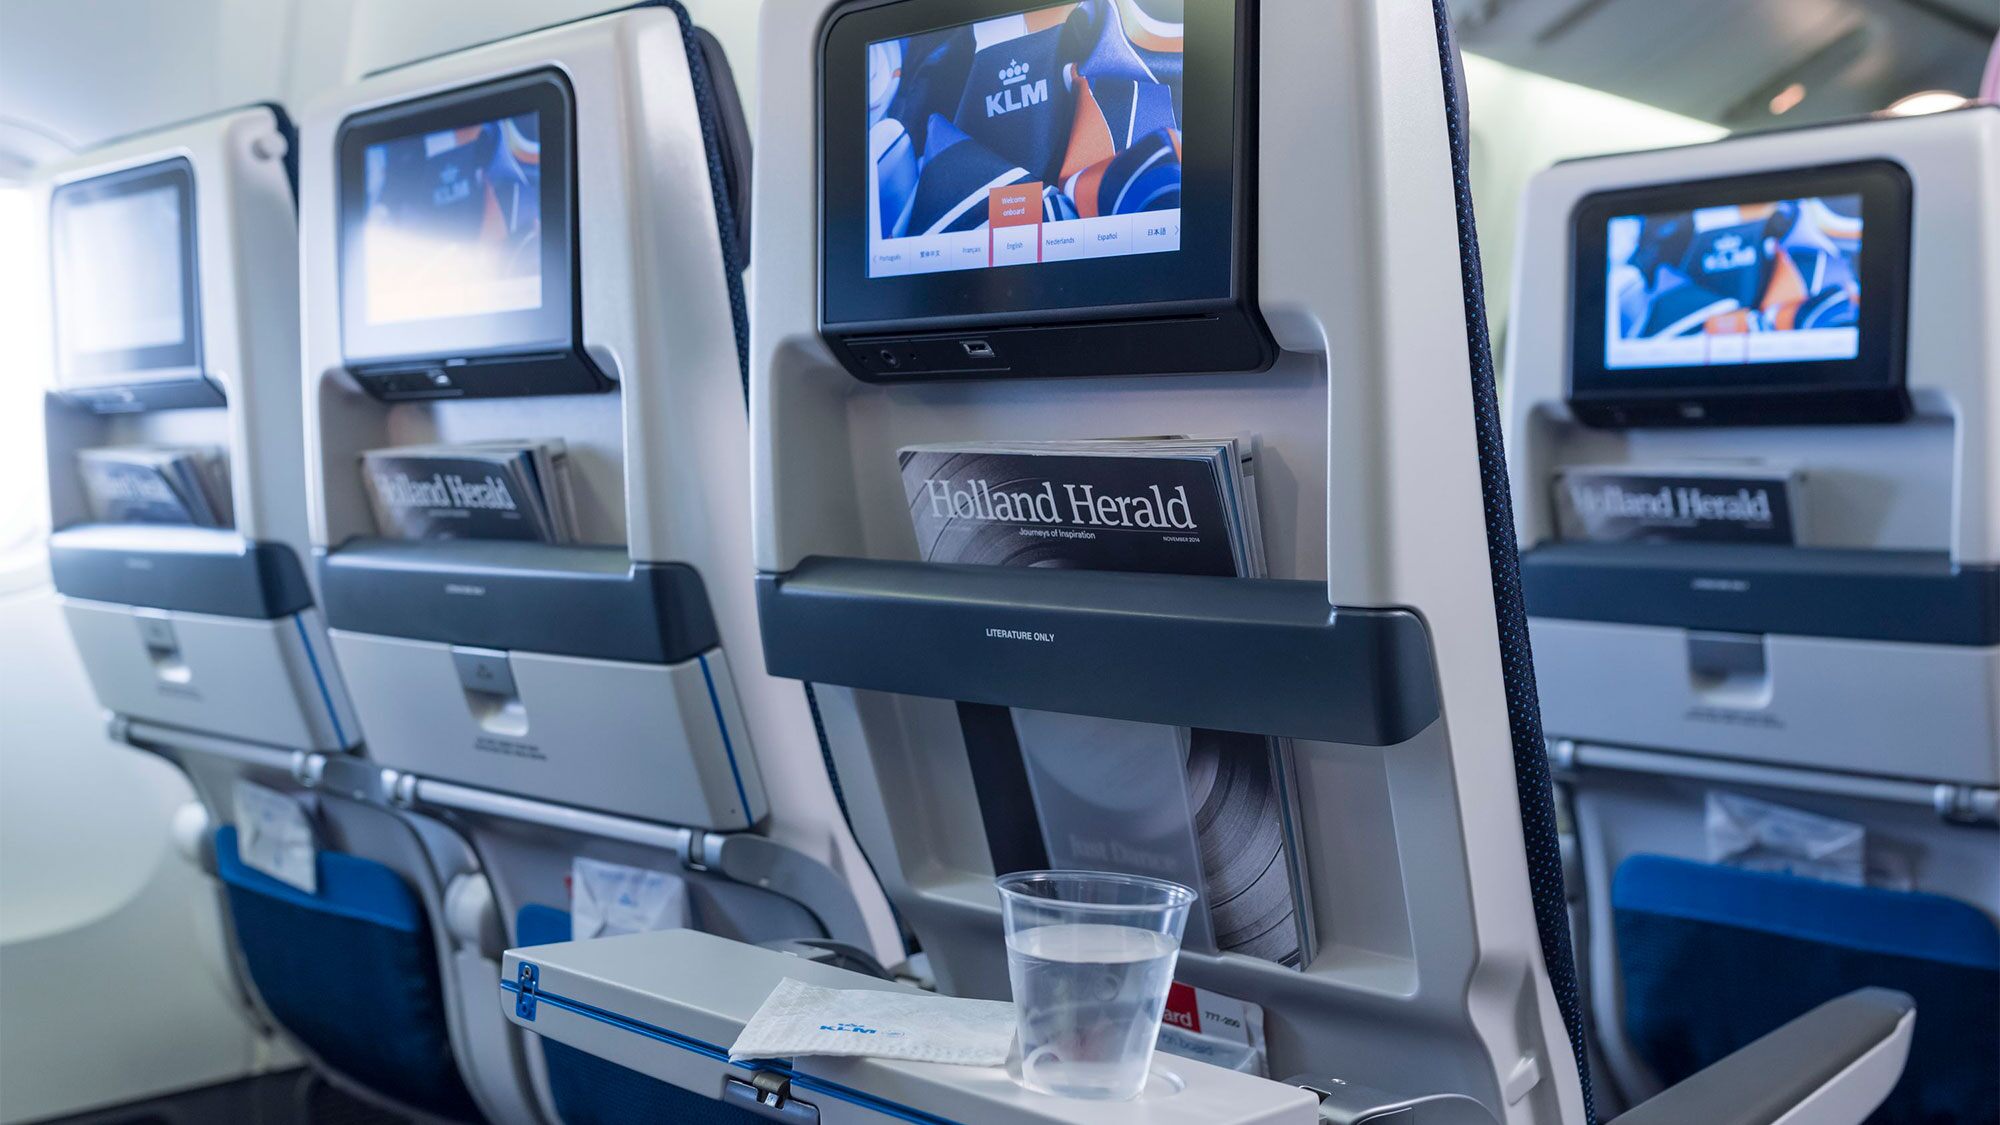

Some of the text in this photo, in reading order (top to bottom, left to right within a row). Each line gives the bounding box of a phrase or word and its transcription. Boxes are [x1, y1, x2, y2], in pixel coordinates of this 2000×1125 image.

[985, 79, 1048, 118] KLM
[1001, 195, 1026, 205] Welcome
[1002, 207, 1025, 217] onboard
[1097, 231, 1118, 242] Español
[1147, 226, 1167, 237] 日本語
[1006, 242, 1024, 251] English
[1045, 236, 1075, 246] Nederlands
[962, 246, 981, 255] Français
[445, 474, 517, 510] Herald
[925, 479, 1197, 530] Holland Herald
[1676, 487, 1772, 521] Herald
[1019, 527, 1096, 540] Journeys of Inspiration
[1162, 535, 1189, 543] NOVEMBER
[985, 628, 1055, 642] LITERATURE ONLY
[1164, 1009, 1193, 1028] ard
[1204, 1011, 1241, 1029] 777-200
[819, 1025, 877, 1034] KLM
